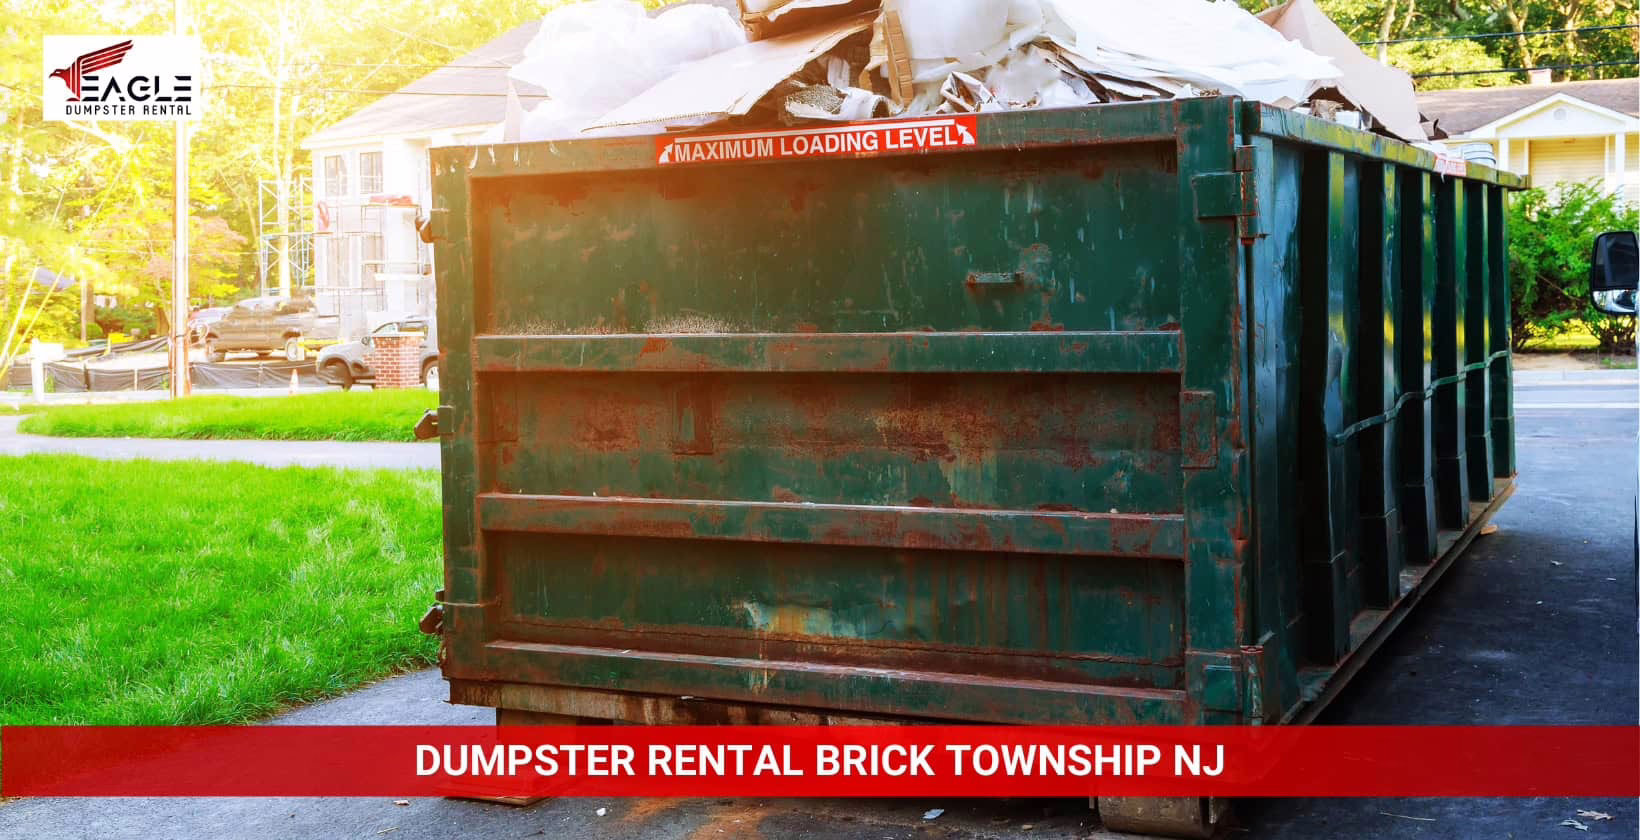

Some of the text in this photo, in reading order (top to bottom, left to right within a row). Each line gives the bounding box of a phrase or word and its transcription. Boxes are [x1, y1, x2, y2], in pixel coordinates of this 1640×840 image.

[674, 125, 958, 163] MAXIMUM LOADING LEVEL
